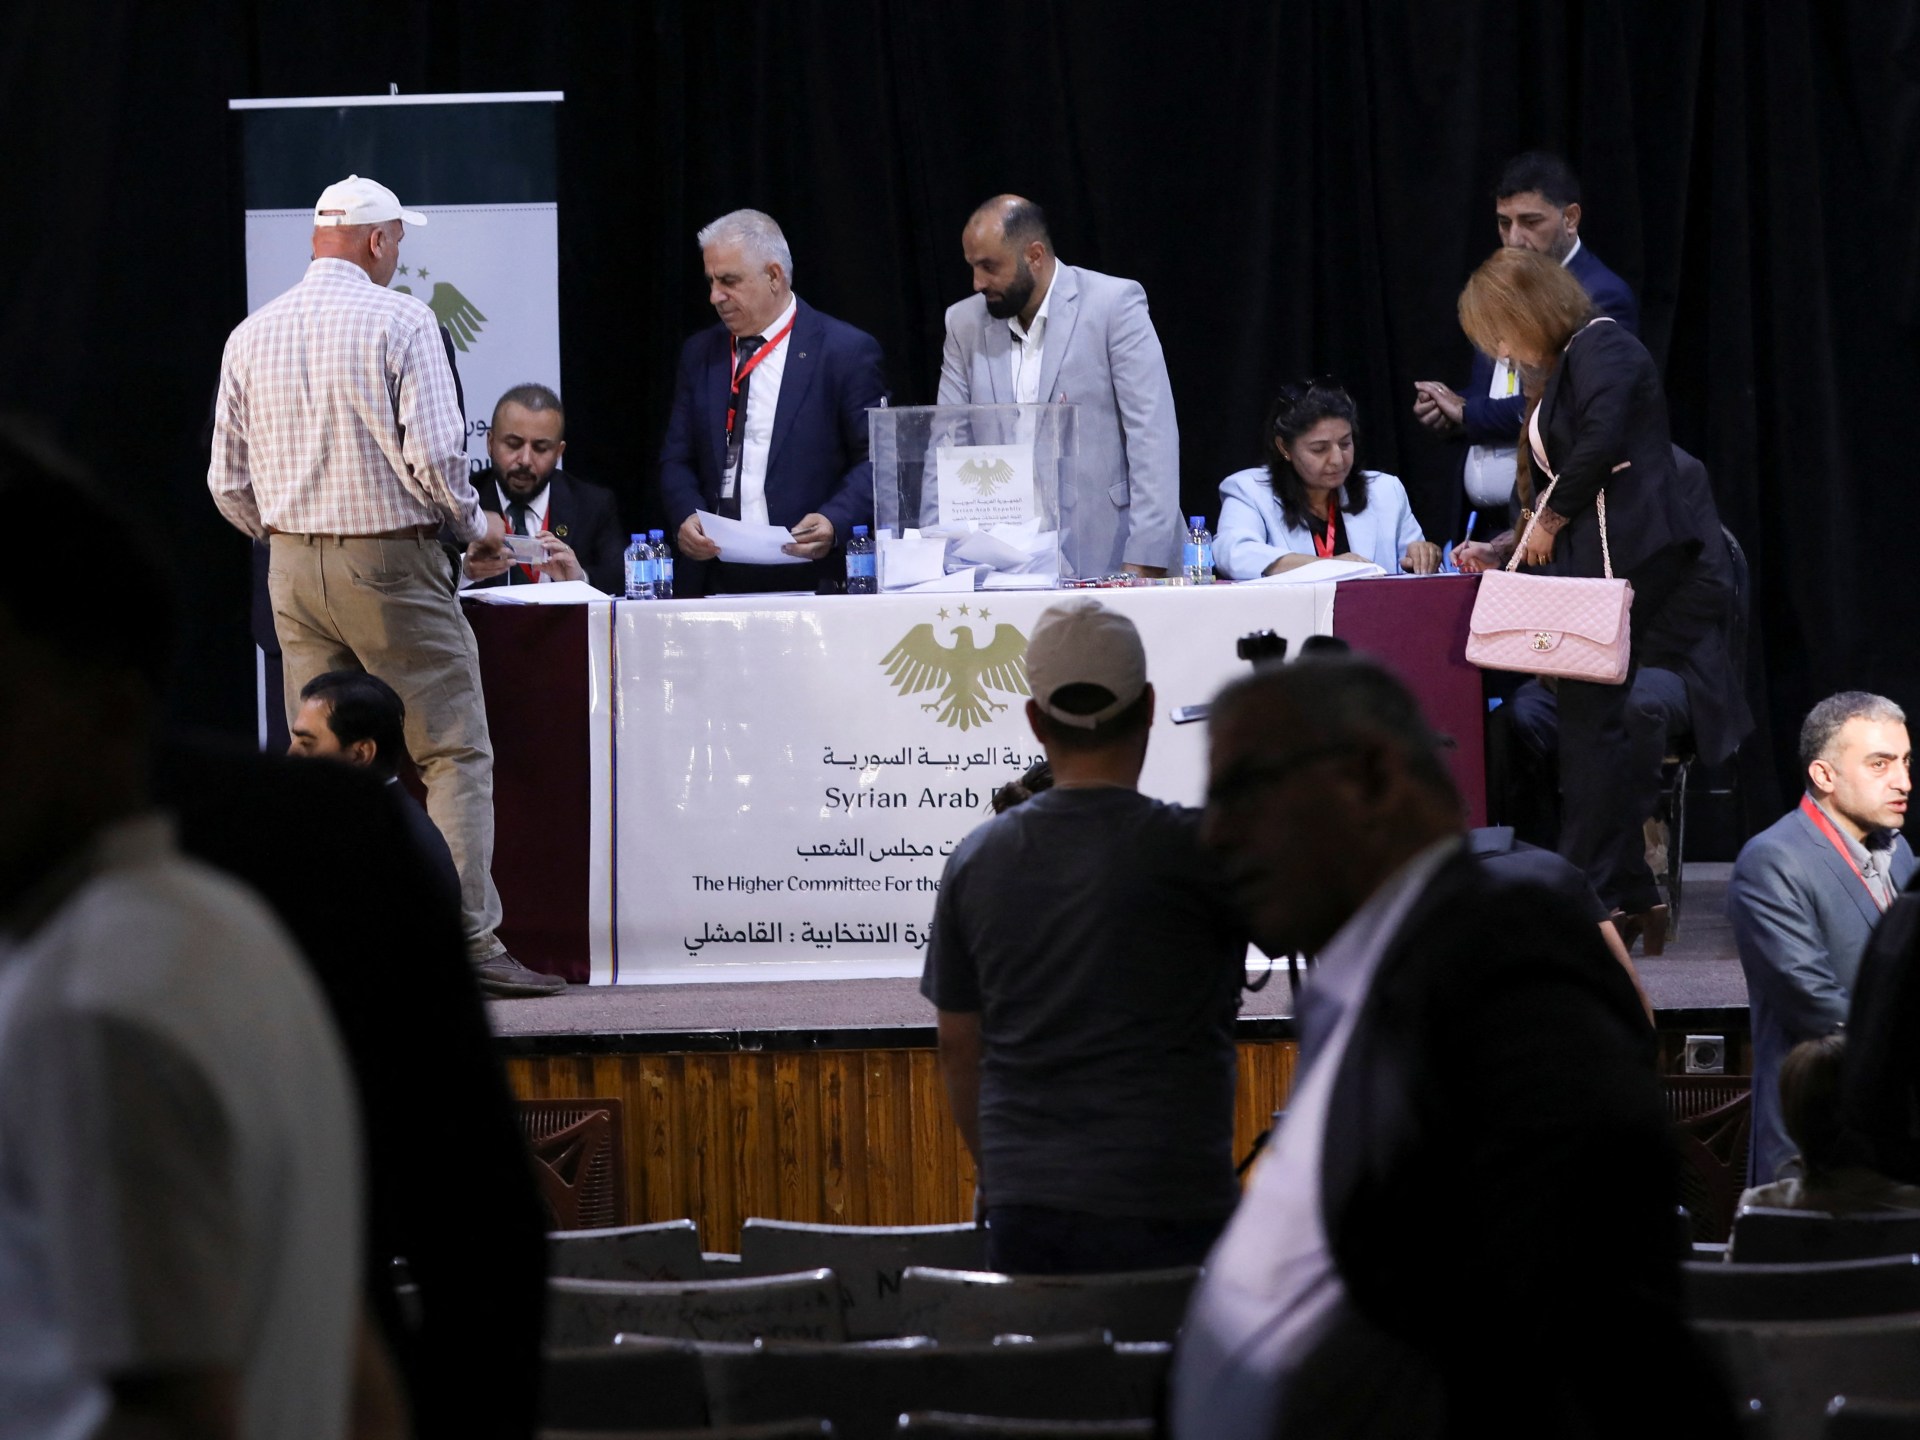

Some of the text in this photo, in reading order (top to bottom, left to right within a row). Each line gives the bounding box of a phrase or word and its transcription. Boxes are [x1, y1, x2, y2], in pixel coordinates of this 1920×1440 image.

[822, 746, 912, 772] السورية
[917, 746, 997, 772] العربية
[825, 786, 908, 813] Syrian
[917, 787, 980, 809] Arab
[796, 837, 864, 860] الشعب
[868, 838, 934, 862] مجلس
[692, 875, 942, 895] The Higher Committee For the
[683, 921, 783, 957] القامشلي
[801, 921, 898, 949] الانتخابية
